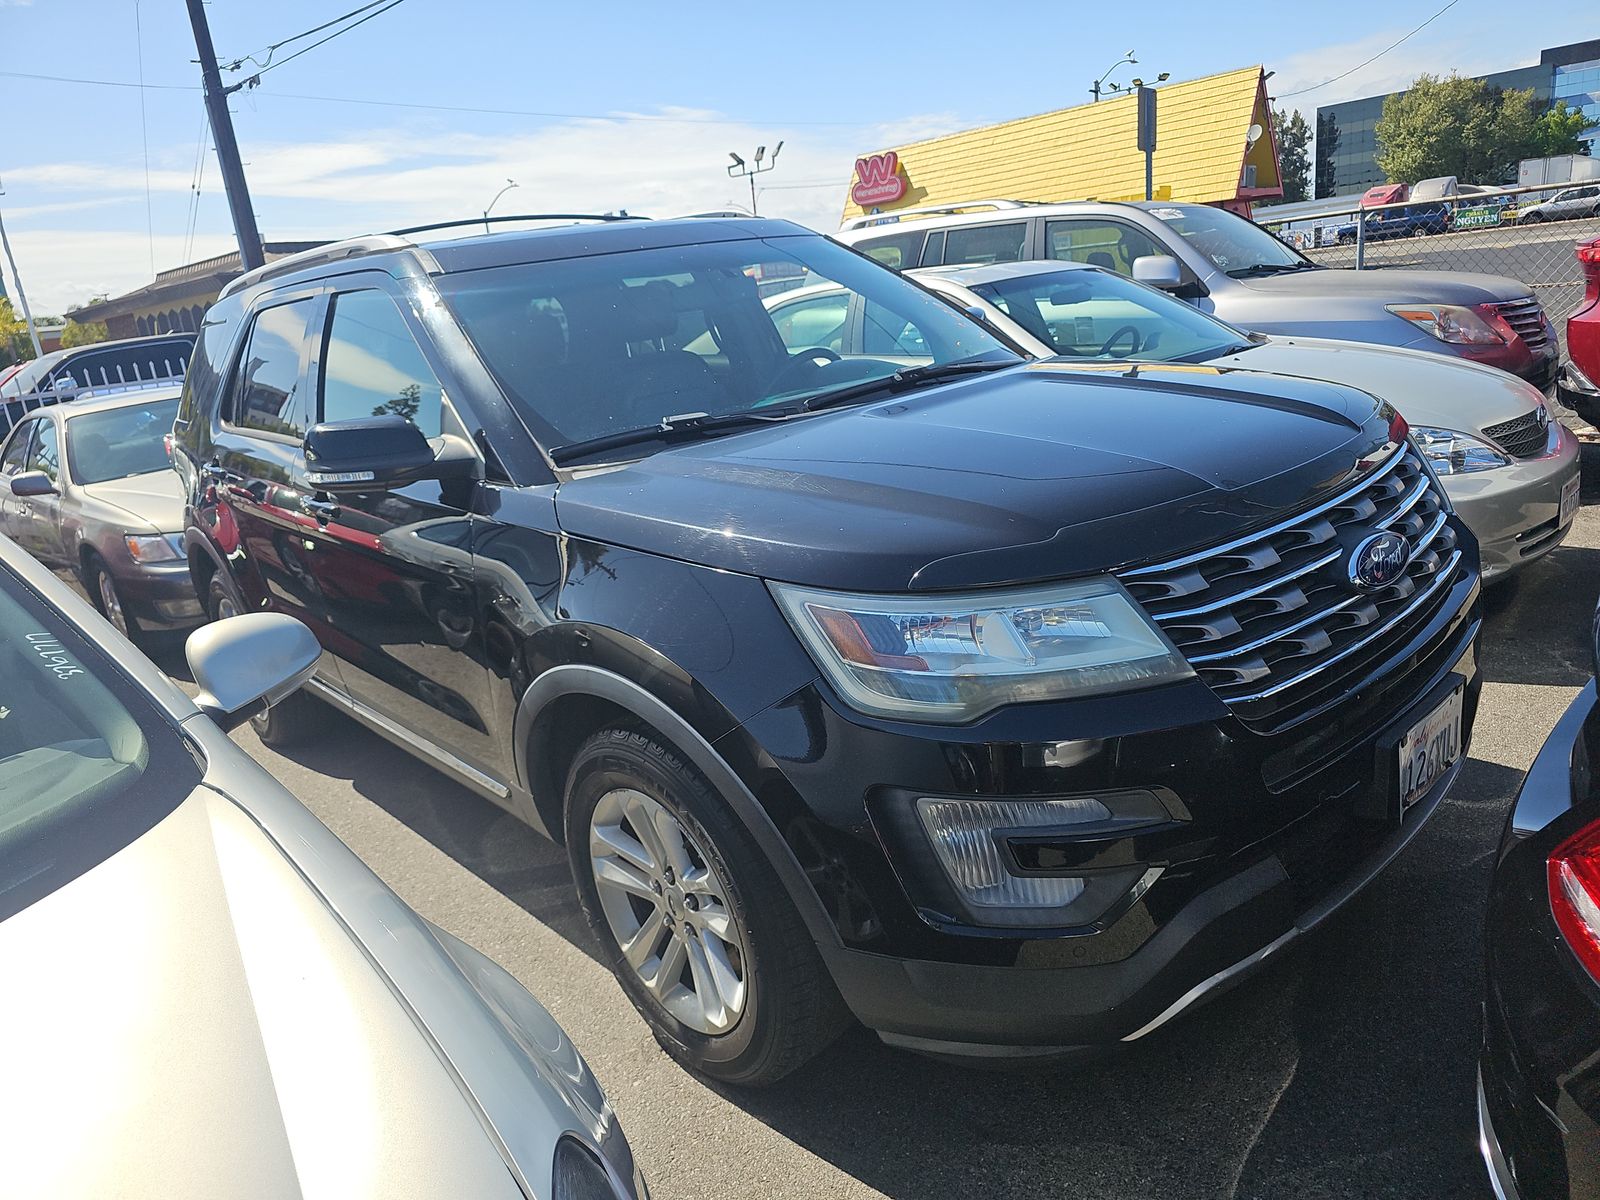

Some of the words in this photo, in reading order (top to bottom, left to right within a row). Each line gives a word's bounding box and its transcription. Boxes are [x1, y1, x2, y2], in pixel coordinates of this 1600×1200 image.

[856, 153, 896, 187] W
[1456, 214, 1498, 226] NGUYEN
[1370, 541, 1404, 579] Ford
